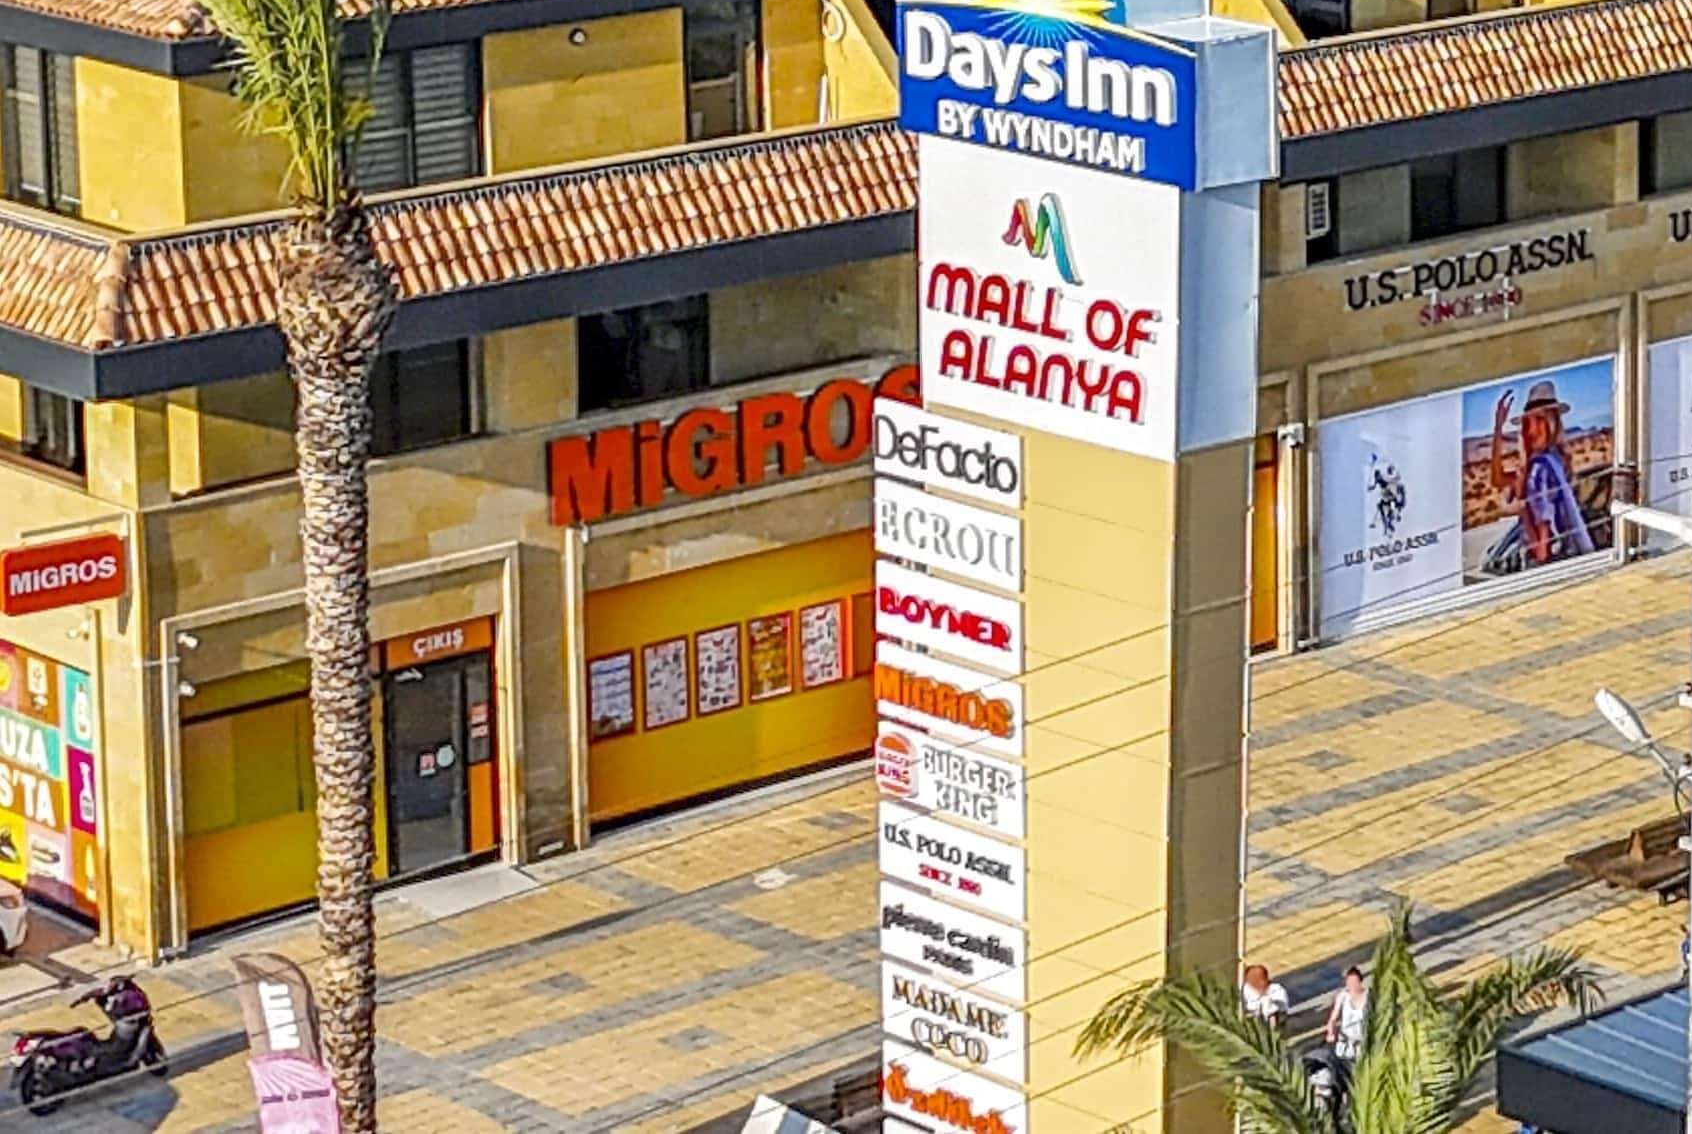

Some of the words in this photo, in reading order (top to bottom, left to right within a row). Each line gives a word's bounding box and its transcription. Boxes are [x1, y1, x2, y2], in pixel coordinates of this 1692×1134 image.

[903, 10, 1064, 103] Days
[1065, 40, 1178, 127] Inn
[936, 98, 974, 138] BY
[982, 109, 1147, 175] WYNDHAM
[1343, 268, 1405, 311] U.S.
[1412, 250, 1498, 297] POLO
[1505, 228, 1594, 278] ASSN.
[927, 262, 1069, 342] MALL
[1085, 299, 1161, 358] OF
[938, 328, 1145, 425] ALANYA
[874, 413, 1018, 494] DeFacto
[412, 627, 465, 659] ÇIKIŞ
[878, 586, 1013, 652] BOYNER
[922, 743, 1017, 801] BURGER
[934, 778, 999, 826] KING
[916, 833, 962, 866] POLO
[881, 902, 946, 942] pierre
[946, 927, 1016, 968] cardin
[891, 973, 1010, 1040] MADAME
[910, 1016, 990, 1065] COCO
